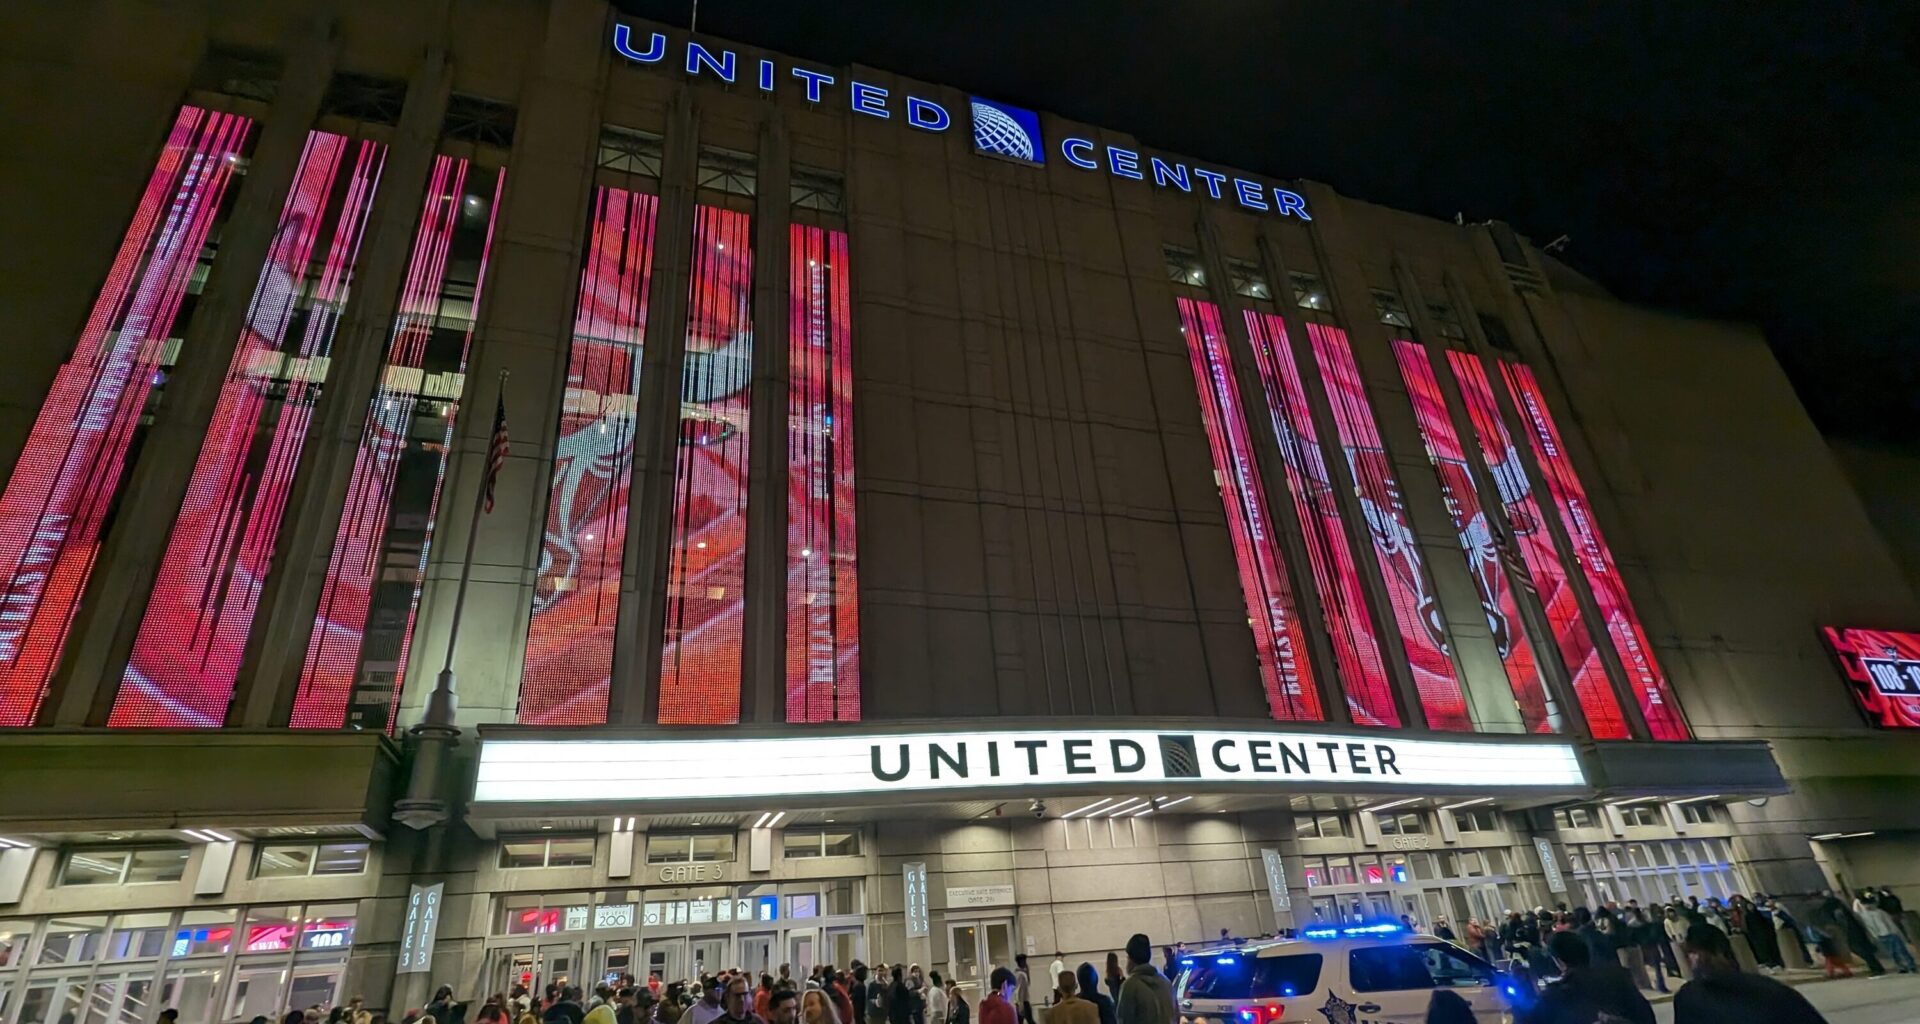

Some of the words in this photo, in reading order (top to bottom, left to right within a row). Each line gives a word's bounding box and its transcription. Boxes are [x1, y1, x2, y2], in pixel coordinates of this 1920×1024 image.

[614, 23, 950, 131] UNITED
[1061, 138, 1312, 220] CENTER
[1266, 597, 1287, 632] WIN
[1274, 636, 1302, 694] BULLS
[1633, 655, 1663, 704] BULLS
[870, 738, 1147, 782] UNITED
[1212, 738, 1401, 775] CENTER
[1393, 838, 1420, 849] GATE
[1422, 836, 1430, 848] 2
[660, 865, 705, 882] GATE
[712, 864, 723, 880] 3
[1268, 855, 1281, 894] GATE
[1279, 897, 1285, 907] 2
[409, 892, 420, 949] GATE
[424, 891, 437, 948] GATE
[600, 914, 626, 927] 200
[907, 871, 916, 918] GATE
[913, 920, 918, 932] 3
[923, 919, 928, 931] 3
[402, 952, 410, 967] 3
[418, 951, 426, 966] 3
